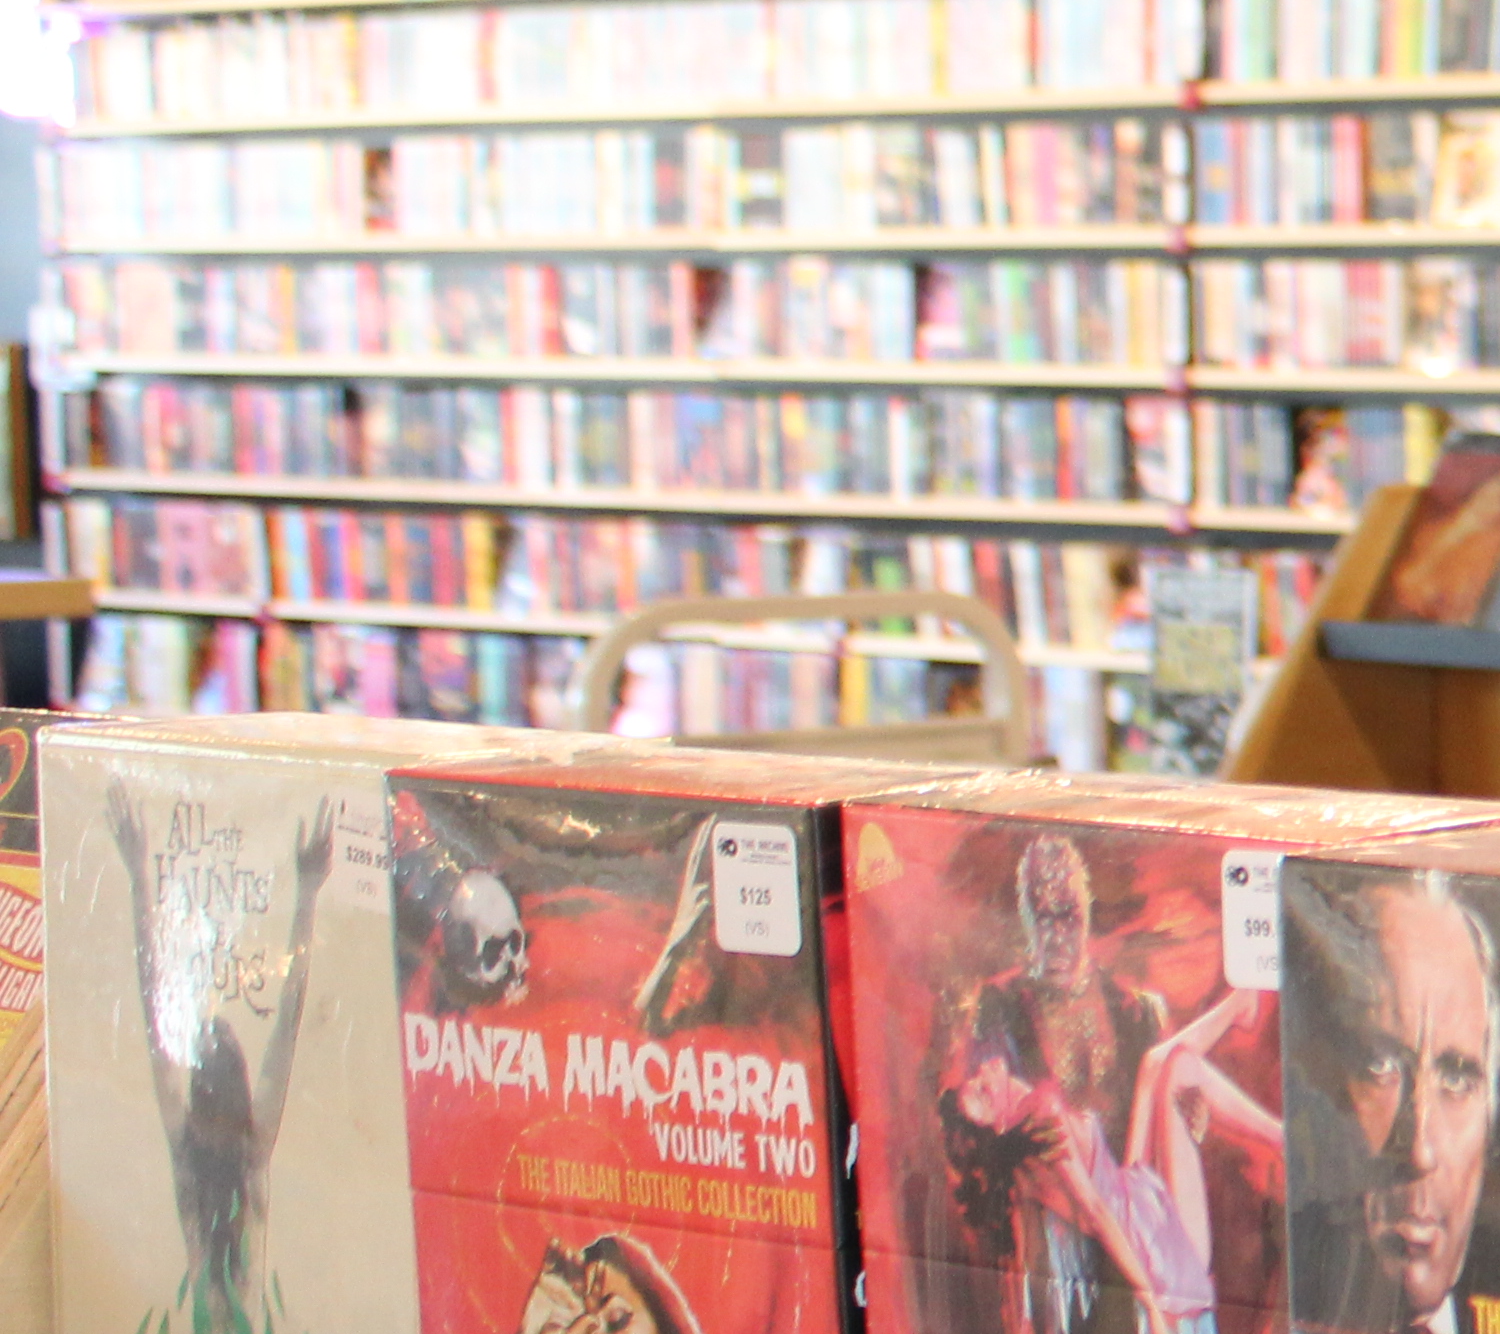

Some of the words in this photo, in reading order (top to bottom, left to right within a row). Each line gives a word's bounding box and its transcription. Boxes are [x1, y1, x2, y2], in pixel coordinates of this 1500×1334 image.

[168, 801, 211, 856] ALL
[740, 886, 773, 907] $125
[402, 1012, 550, 1109] DANZA
[559, 1031, 815, 1137] MACABRA
[653, 1122, 747, 1169] VOLUME
[755, 1133, 818, 1179] TWO
[517, 1154, 551, 1191] THE
[554, 1159, 620, 1207] ITALIAN
[626, 1172, 694, 1217] GOTHIC
[699, 1181, 818, 1229] COLLECTION
